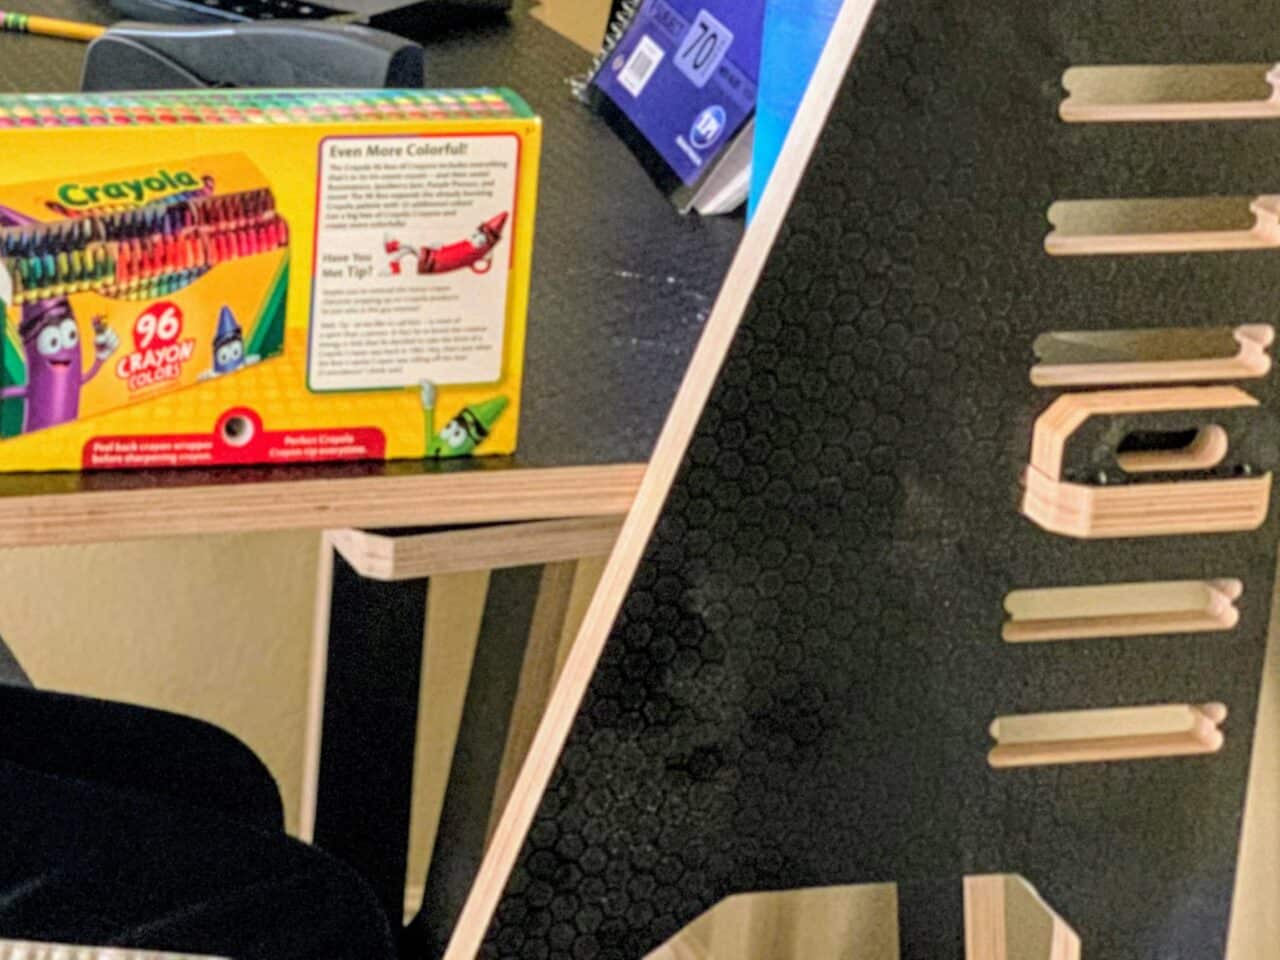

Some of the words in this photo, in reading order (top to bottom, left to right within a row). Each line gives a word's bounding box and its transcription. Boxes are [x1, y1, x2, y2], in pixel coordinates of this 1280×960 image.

[682, 20, 717, 70] 70
[330, 145, 362, 157] Even
[366, 144, 403, 156] More
[407, 142, 469, 156] Colorful!
[58, 170, 198, 206] Crayola
[347, 265, 373, 280] Tip?
[136, 307, 180, 348] 96
[117, 340, 194, 377] CRAYON
